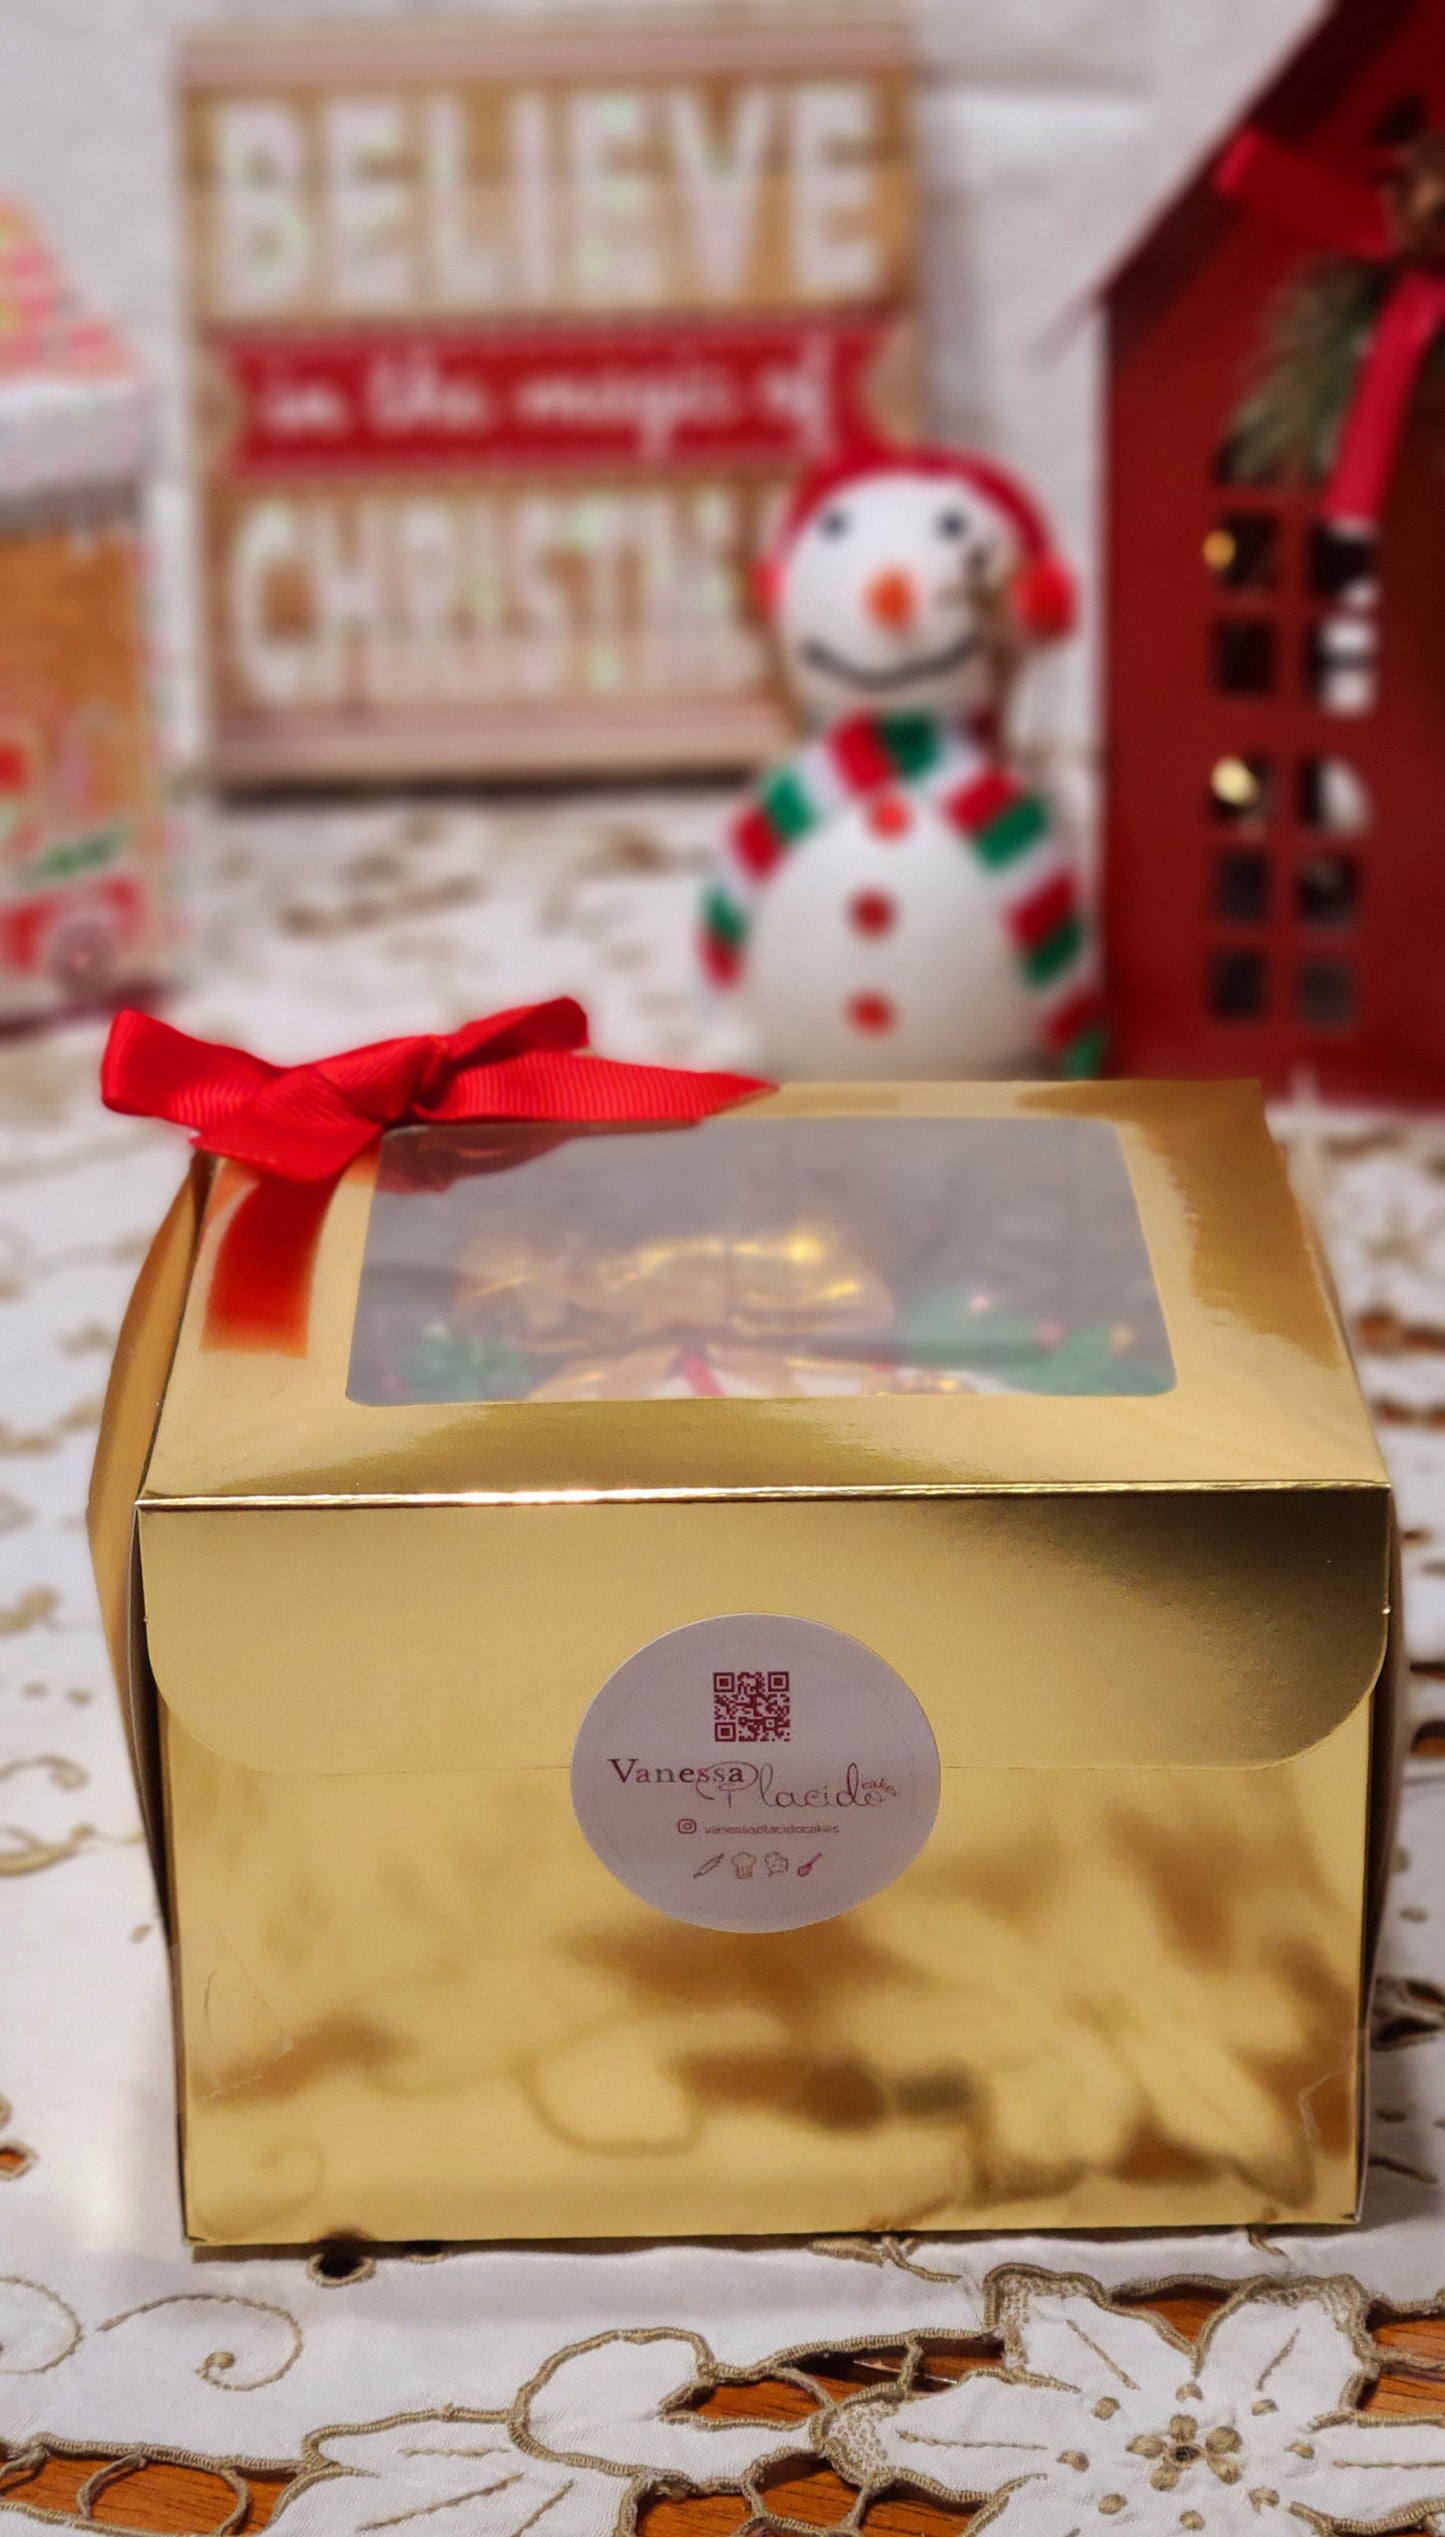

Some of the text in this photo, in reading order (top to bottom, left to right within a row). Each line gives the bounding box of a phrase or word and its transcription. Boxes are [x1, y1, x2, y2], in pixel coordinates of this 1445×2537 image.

[212, 84, 879, 314] BELIEVE
[259, 334, 832, 459] in the magic of
[228, 480, 780, 703] CHRISTM
[609, 1758, 884, 1808] Vanessa Placido
